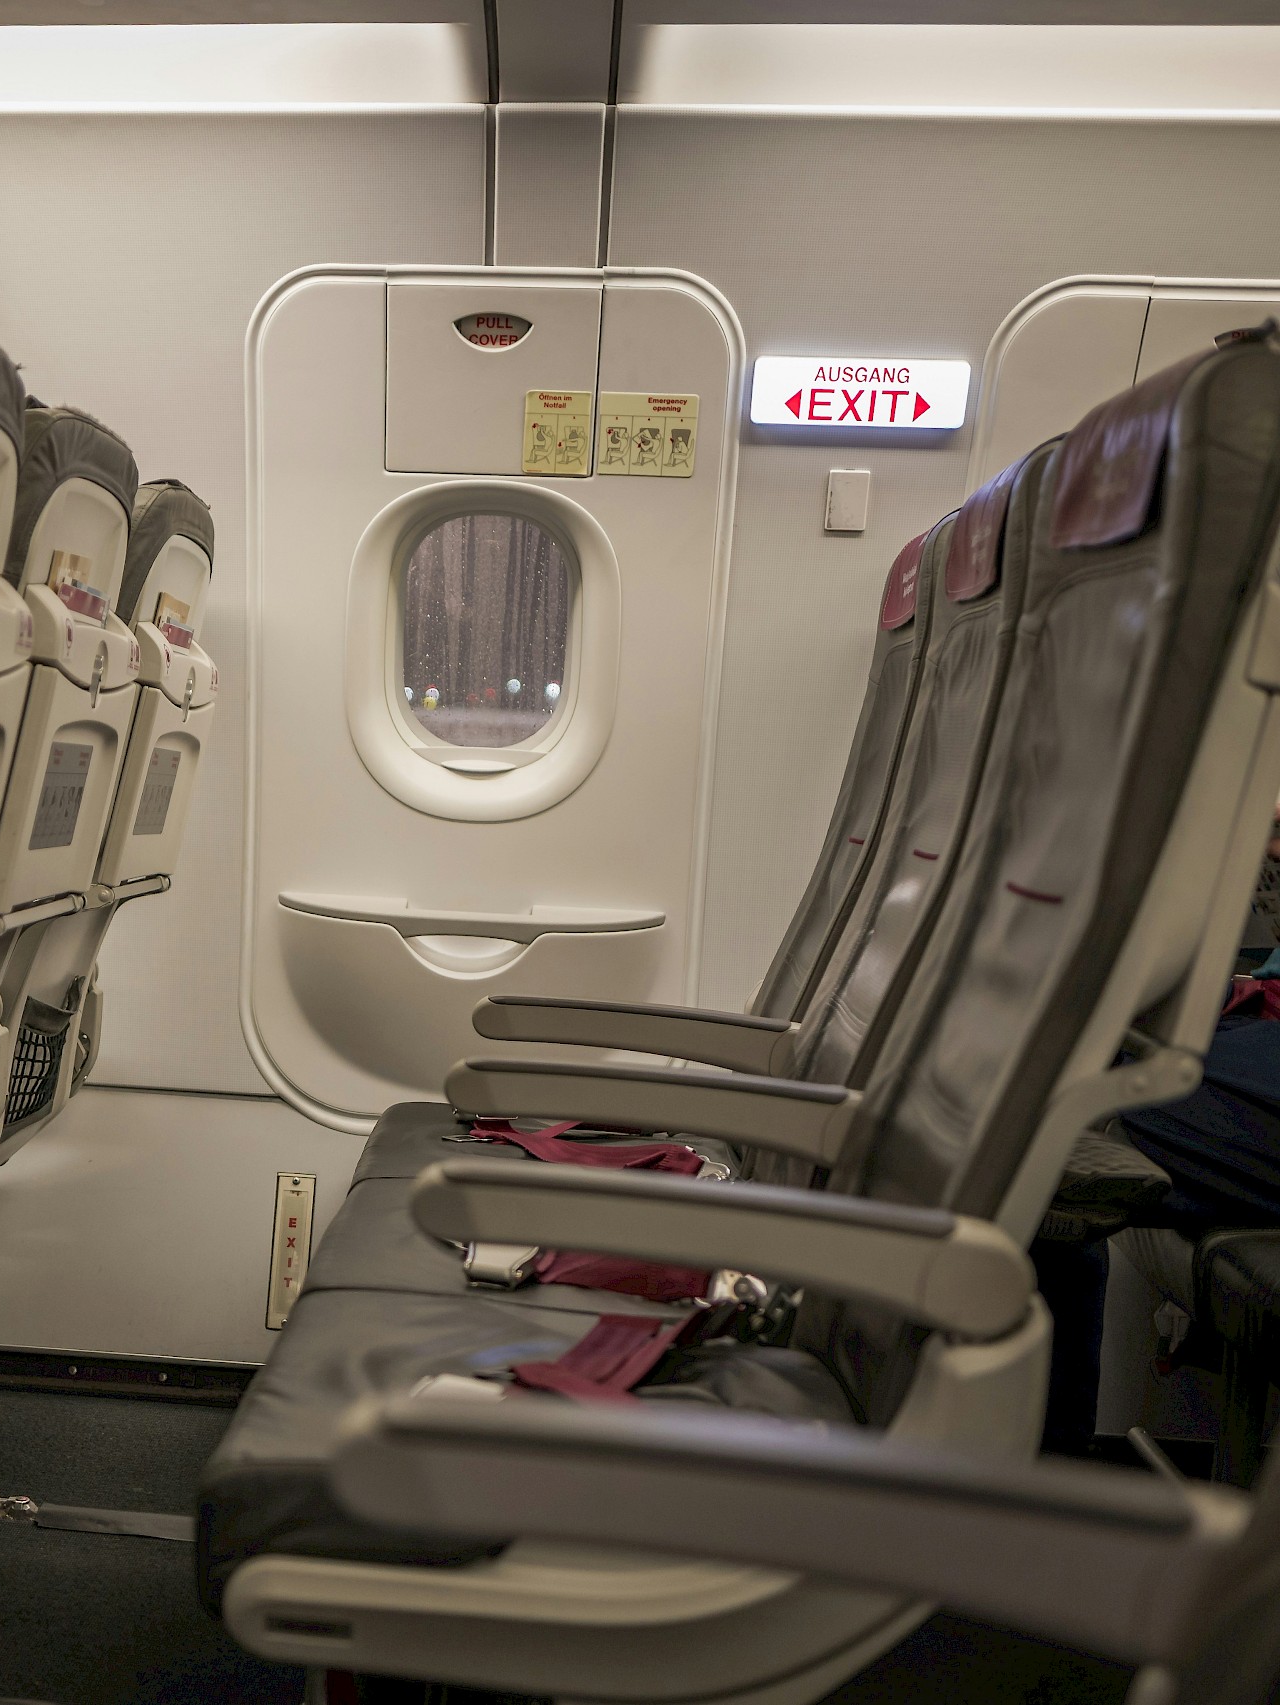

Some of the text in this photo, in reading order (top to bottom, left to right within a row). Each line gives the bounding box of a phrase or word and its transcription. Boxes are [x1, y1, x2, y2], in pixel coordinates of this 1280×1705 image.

[476, 316, 513, 329] PULL
[469, 334, 518, 346] COVER
[814, 366, 910, 383] AUSGANG
[538, 392, 562, 401] Öffnen
[647, 397, 688, 406] Emergency
[652, 405, 682, 413] opening
[808, 388, 910, 423] EXIT
[283, 1217, 297, 1288] EXIT
